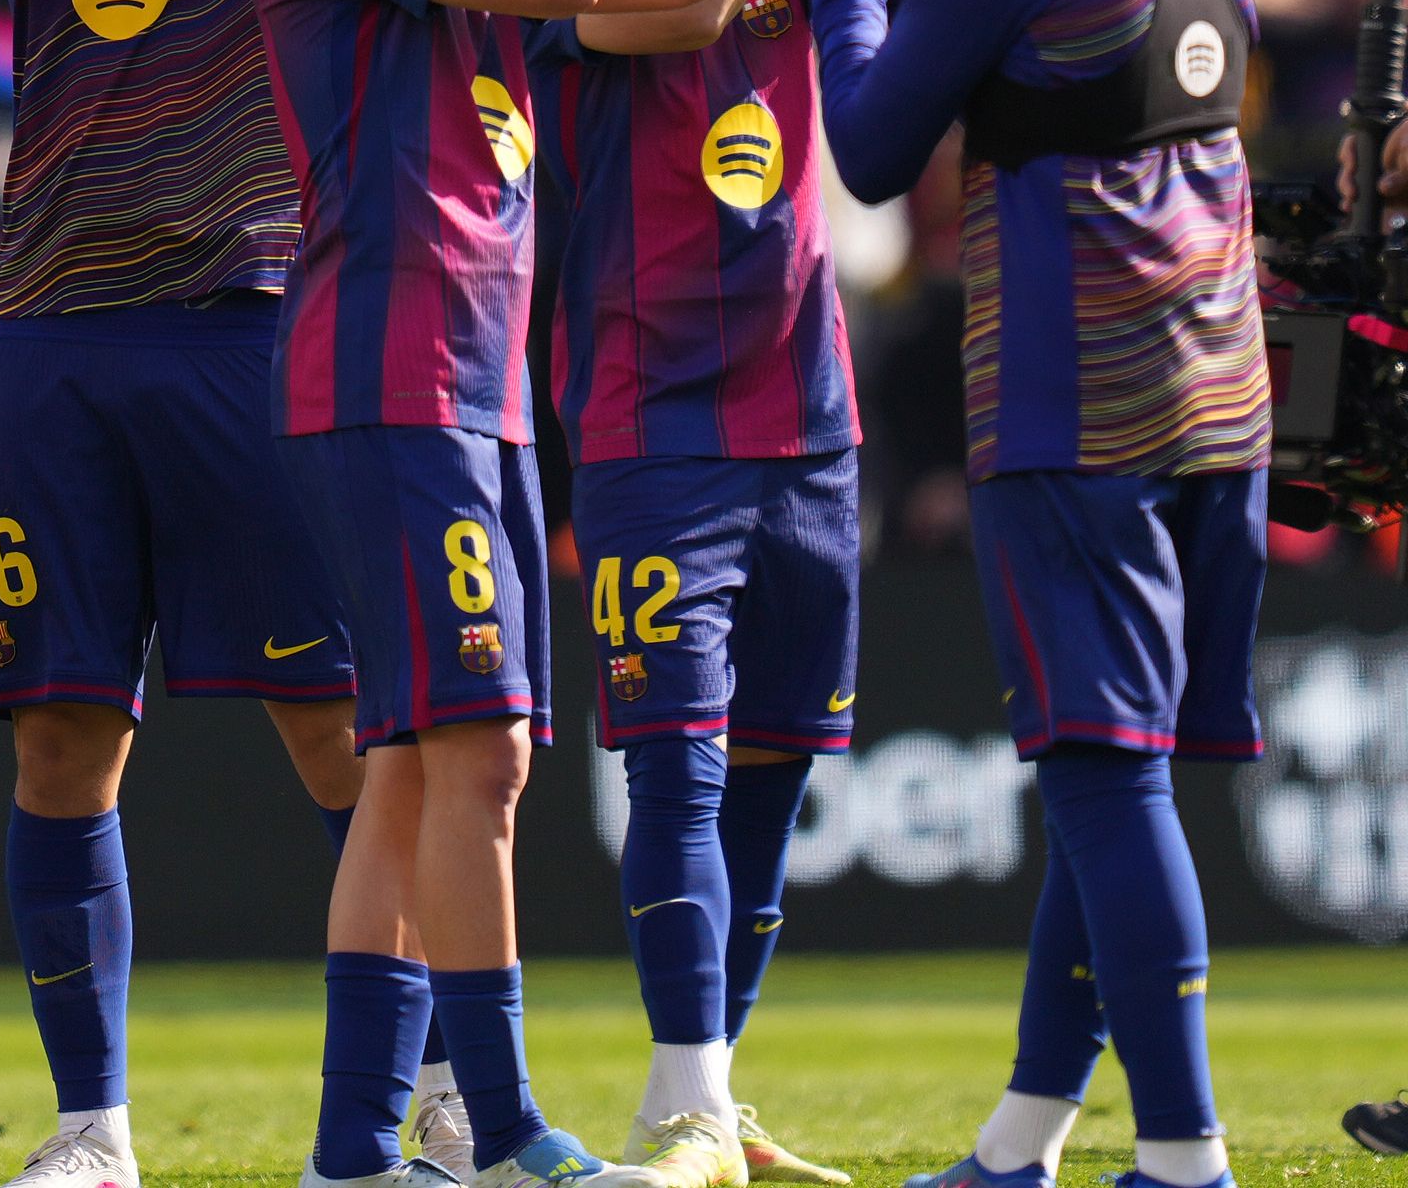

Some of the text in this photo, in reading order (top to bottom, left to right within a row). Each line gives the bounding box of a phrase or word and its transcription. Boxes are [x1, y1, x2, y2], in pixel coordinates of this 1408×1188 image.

[443, 519, 495, 614] 8
[592, 555, 681, 647] 42
[589, 710, 1040, 888] er
